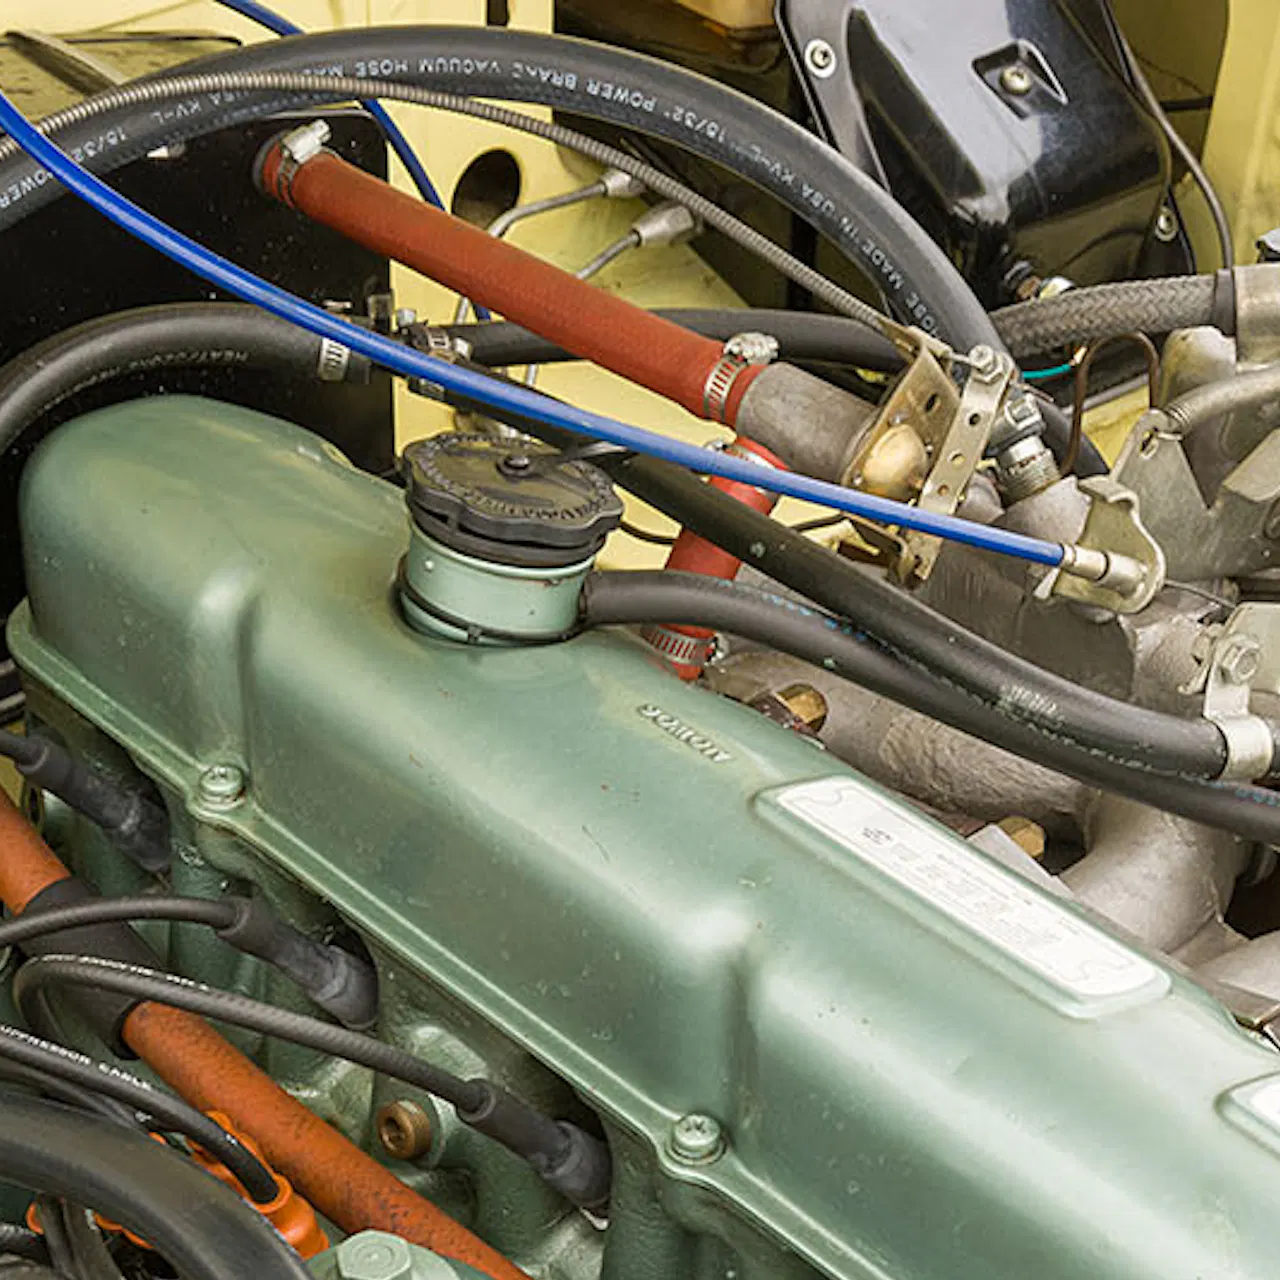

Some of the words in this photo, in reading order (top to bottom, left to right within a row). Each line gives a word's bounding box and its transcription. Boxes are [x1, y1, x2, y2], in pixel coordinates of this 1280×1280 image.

[354, 58, 408, 78] HOSE
[419, 56, 502, 75] VACUUM
[586, 77, 658, 113] POWER
